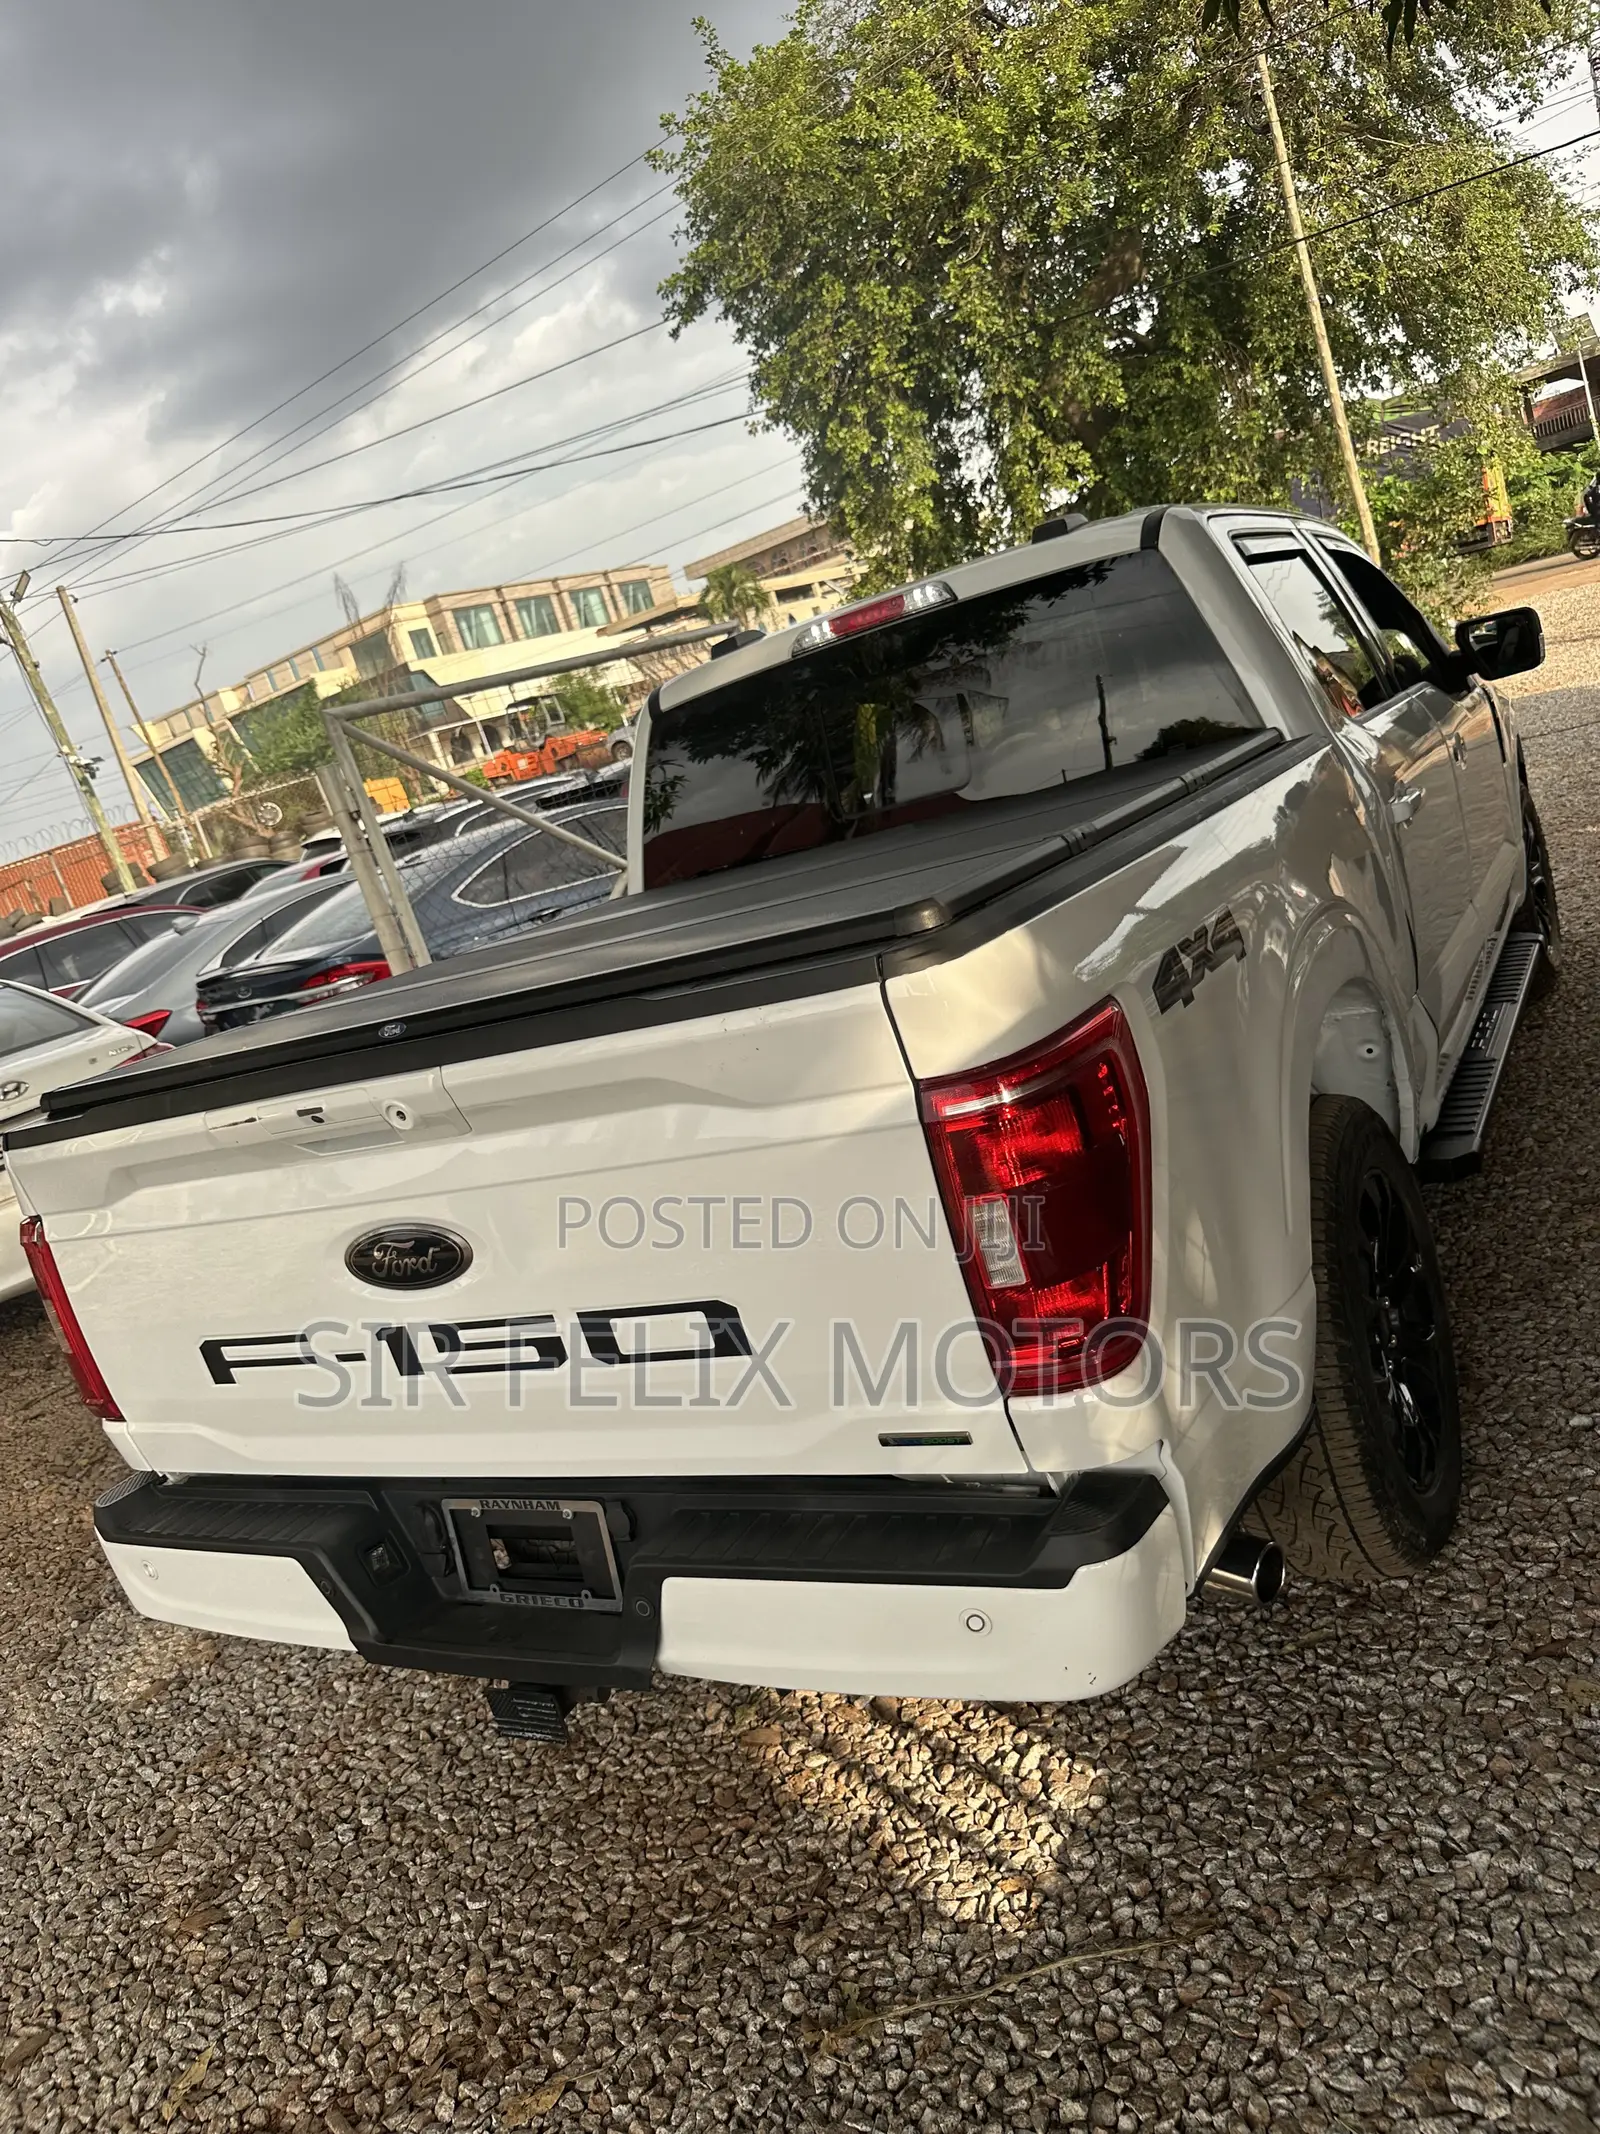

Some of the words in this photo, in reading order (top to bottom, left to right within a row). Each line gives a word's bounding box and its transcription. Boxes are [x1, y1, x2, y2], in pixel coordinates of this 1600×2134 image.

[371, 1240, 441, 1278] Ford
[198, 1299, 753, 1386] F-150
[479, 1499, 562, 1511] RAYNHAM
[500, 1593, 585, 1609] GRIECO
